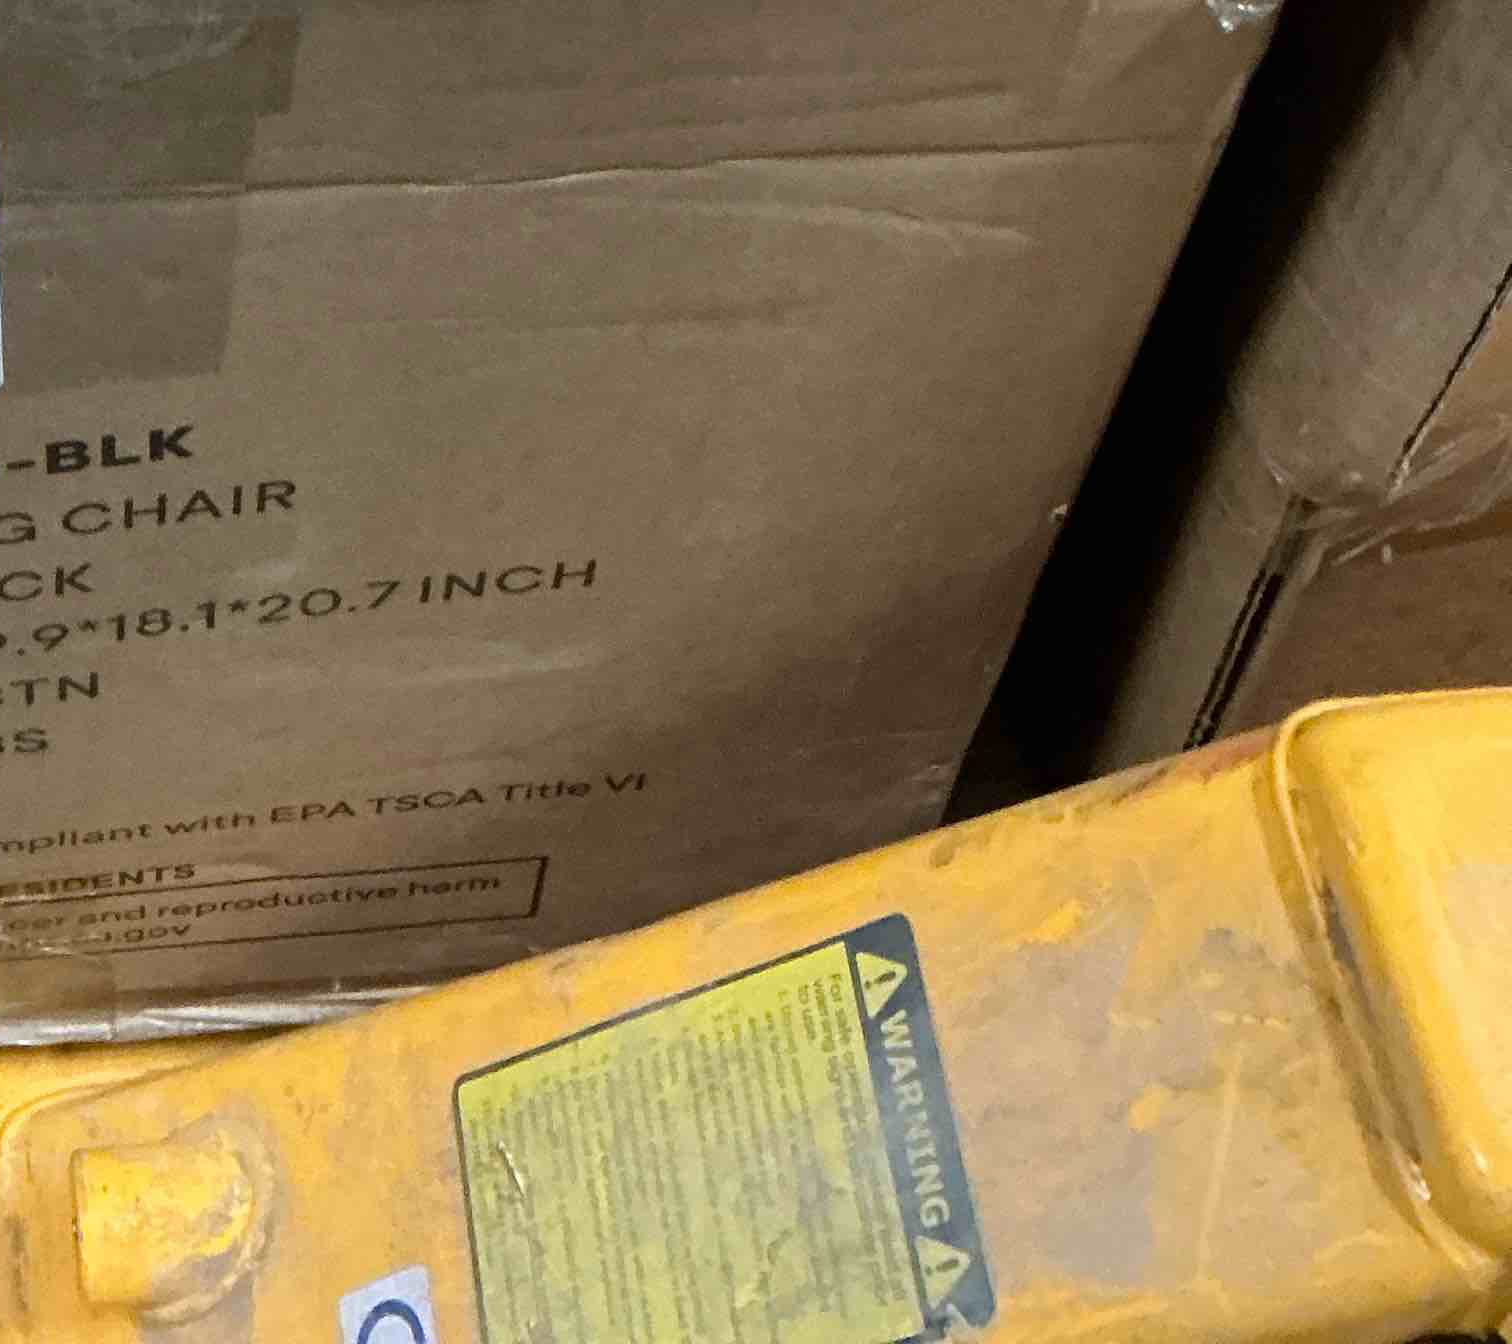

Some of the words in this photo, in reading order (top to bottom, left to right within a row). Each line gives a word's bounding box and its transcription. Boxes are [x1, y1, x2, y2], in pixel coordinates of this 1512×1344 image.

[62, 479, 298, 536] CHAIR
[418, 559, 599, 604] INCH
[164, 807, 256, 835] with
[269, 798, 357, 825] EPA
[367, 785, 486, 814] TSCA
[497, 779, 592, 804] Title
[604, 772, 647, 793] VI
[78, 903, 147, 927] and
[156, 885, 400, 920] reproductive
[407, 874, 502, 898] harm
[879, 1009, 951, 1228] WARNING
